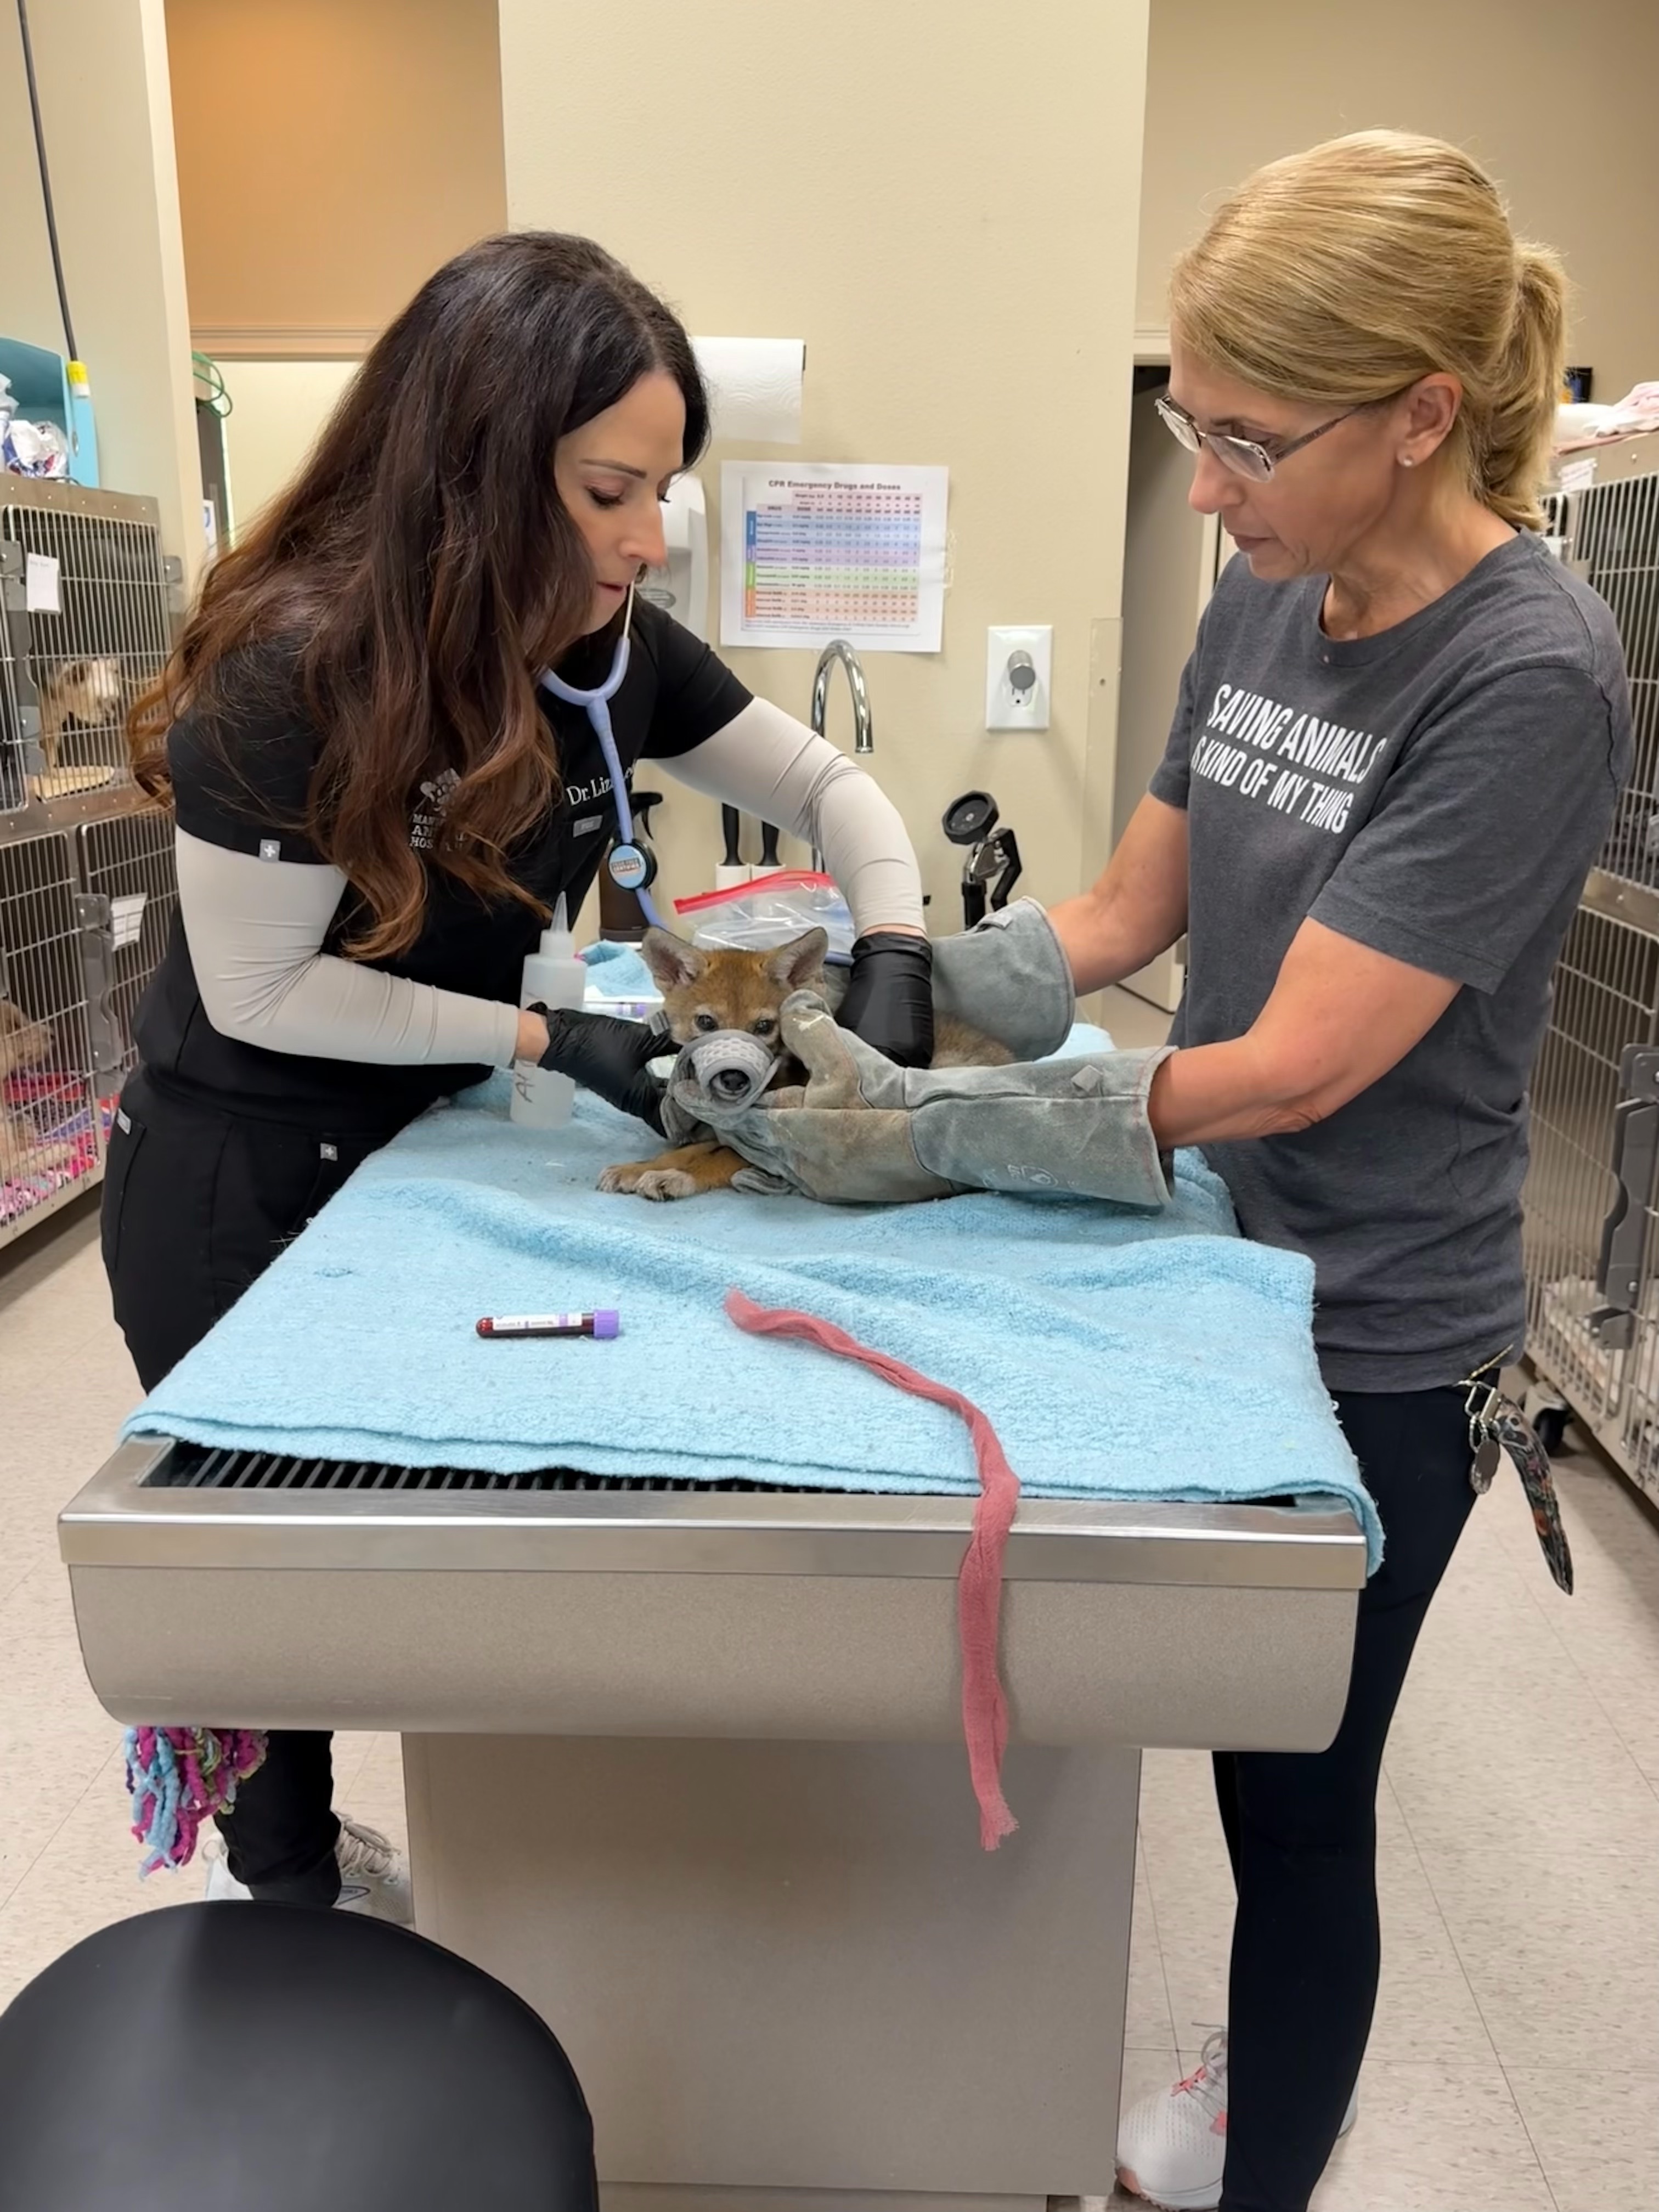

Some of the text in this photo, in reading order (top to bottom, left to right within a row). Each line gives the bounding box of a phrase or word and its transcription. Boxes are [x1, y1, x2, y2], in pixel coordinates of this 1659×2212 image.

[787, 481, 832, 490] Emergency
[834, 482, 857, 490] Drugs
[1207, 684, 1387, 784] SAVING ANIMALS
[566, 786, 591, 806] Dr.
[1195, 739, 1248, 786] KIND
[1239, 758, 1278, 799] OF
[1267, 769, 1310, 814] MY
[1299, 781, 1355, 834] THING
